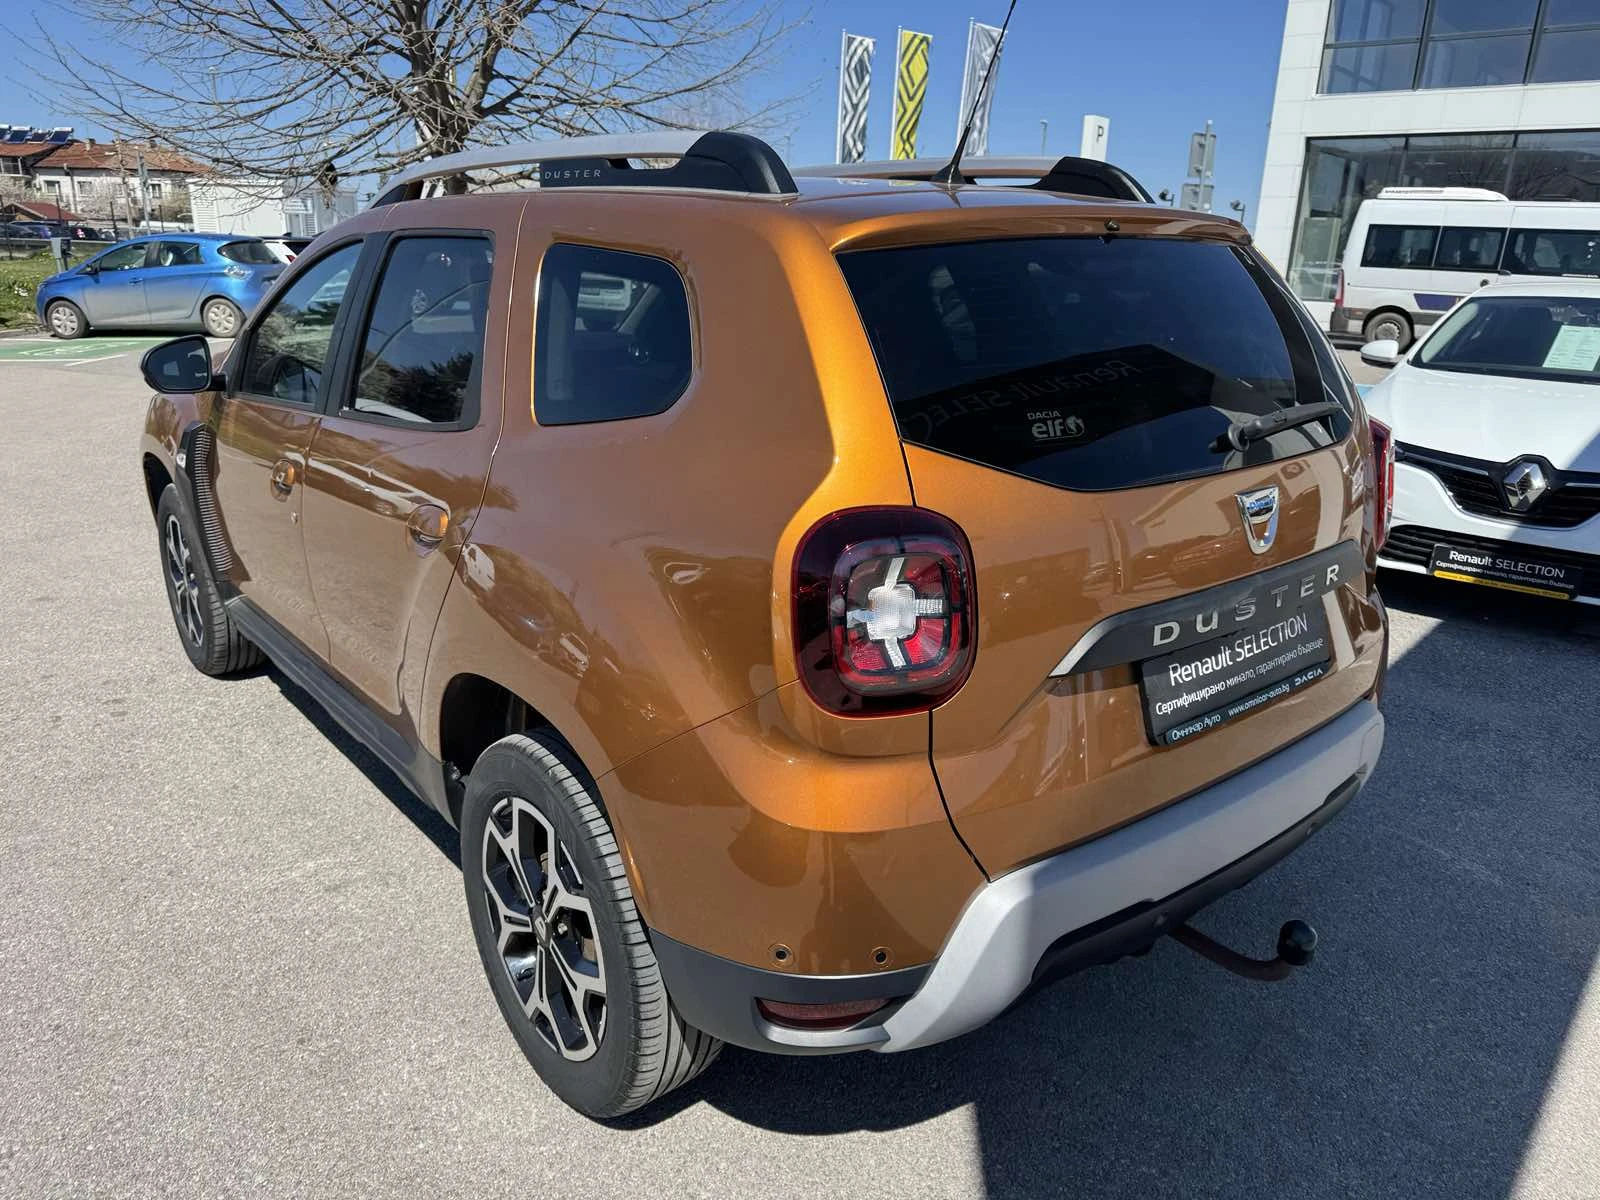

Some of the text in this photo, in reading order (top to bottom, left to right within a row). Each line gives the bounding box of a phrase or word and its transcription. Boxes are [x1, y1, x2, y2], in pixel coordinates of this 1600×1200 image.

[1096, 125, 1104, 144] P
[544, 169, 601, 180] DUSTER
[1027, 410, 1061, 420] DACIA
[1031, 416, 1065, 439] elf
[1449, 550, 1493, 567] Renault
[1495, 558, 1565, 579] SELECTION
[1152, 563, 1340, 647] DUSTER
[1168, 613, 1308, 687] Renault SELECTION
[1155, 680, 1226, 716] Сертифицирано
[1255, 649, 1298, 676] гарантирано
[1297, 637, 1324, 658] бъдеще
[1294, 668, 1323, 687] DACIA
[1227, 682, 1290, 717] www.omnicar-auto.bg
